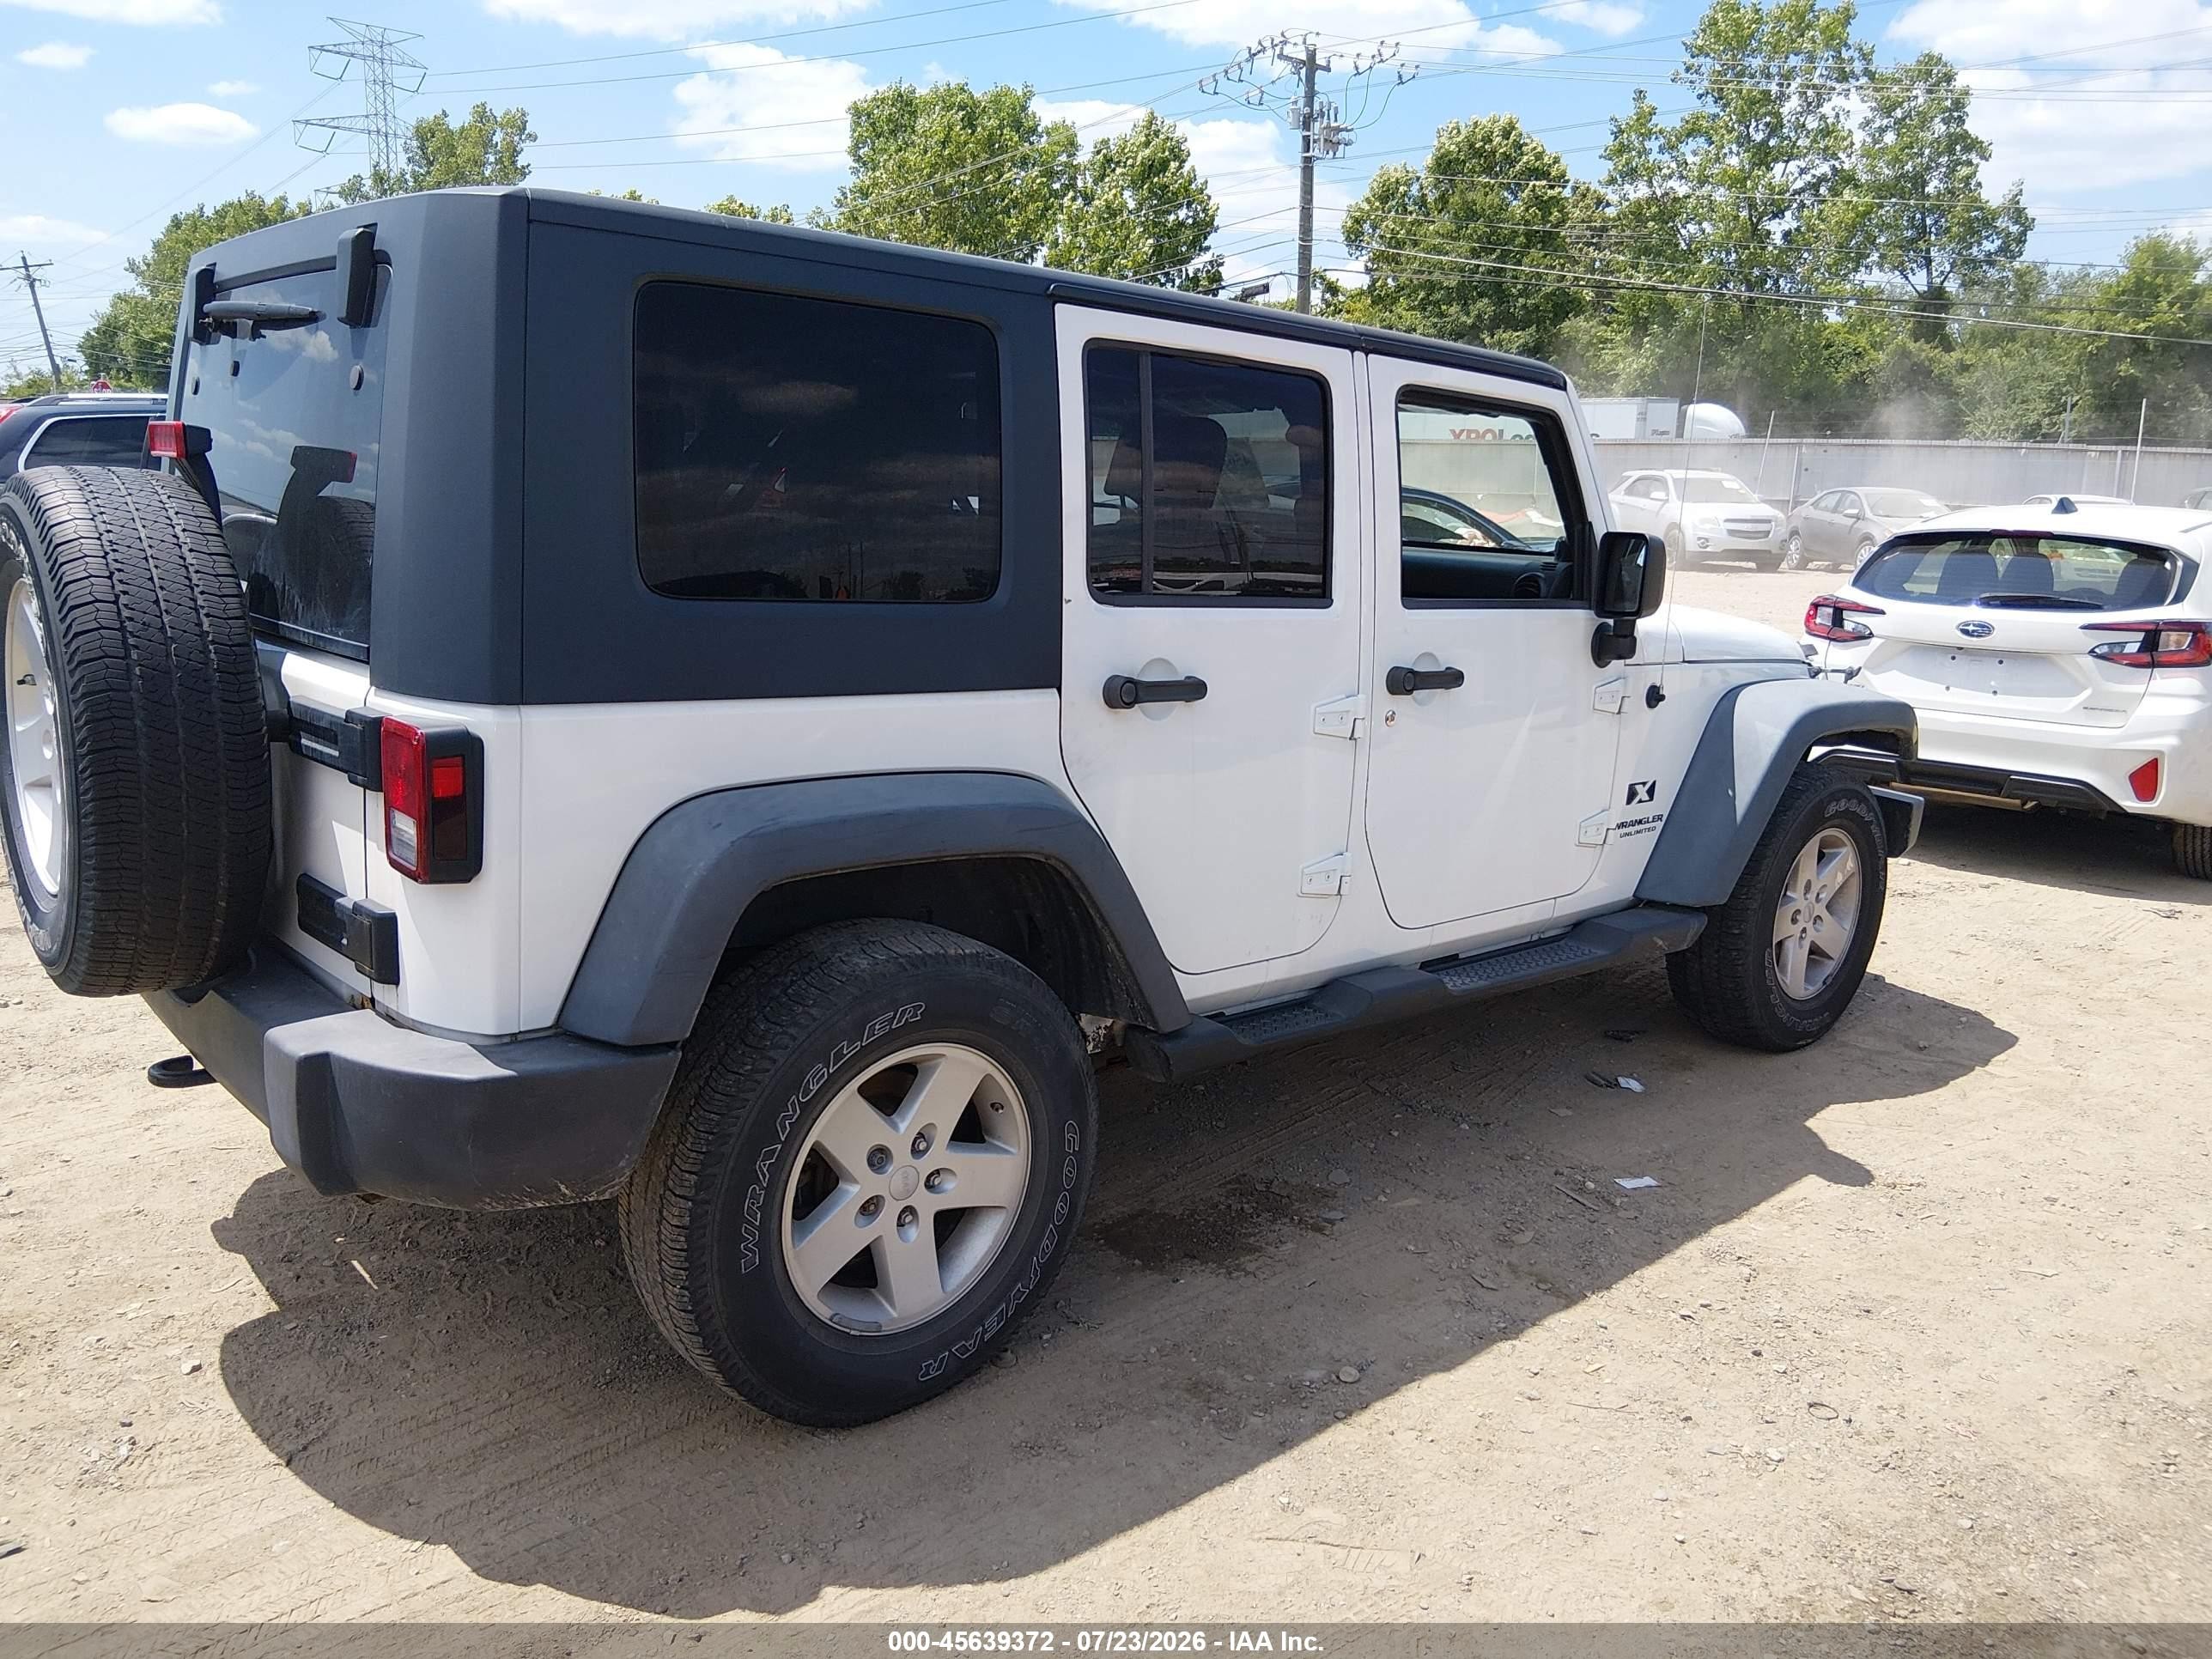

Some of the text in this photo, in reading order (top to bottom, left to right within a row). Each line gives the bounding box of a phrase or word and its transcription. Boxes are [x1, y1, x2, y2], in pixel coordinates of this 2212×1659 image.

[1614, 814, 1664, 830] WRANGLER
[1620, 826, 1656, 838] UNLIMITED
[741, 1002, 926, 1274] WRANGLER
[918, 1120, 1080, 1381] GOODYEAR
